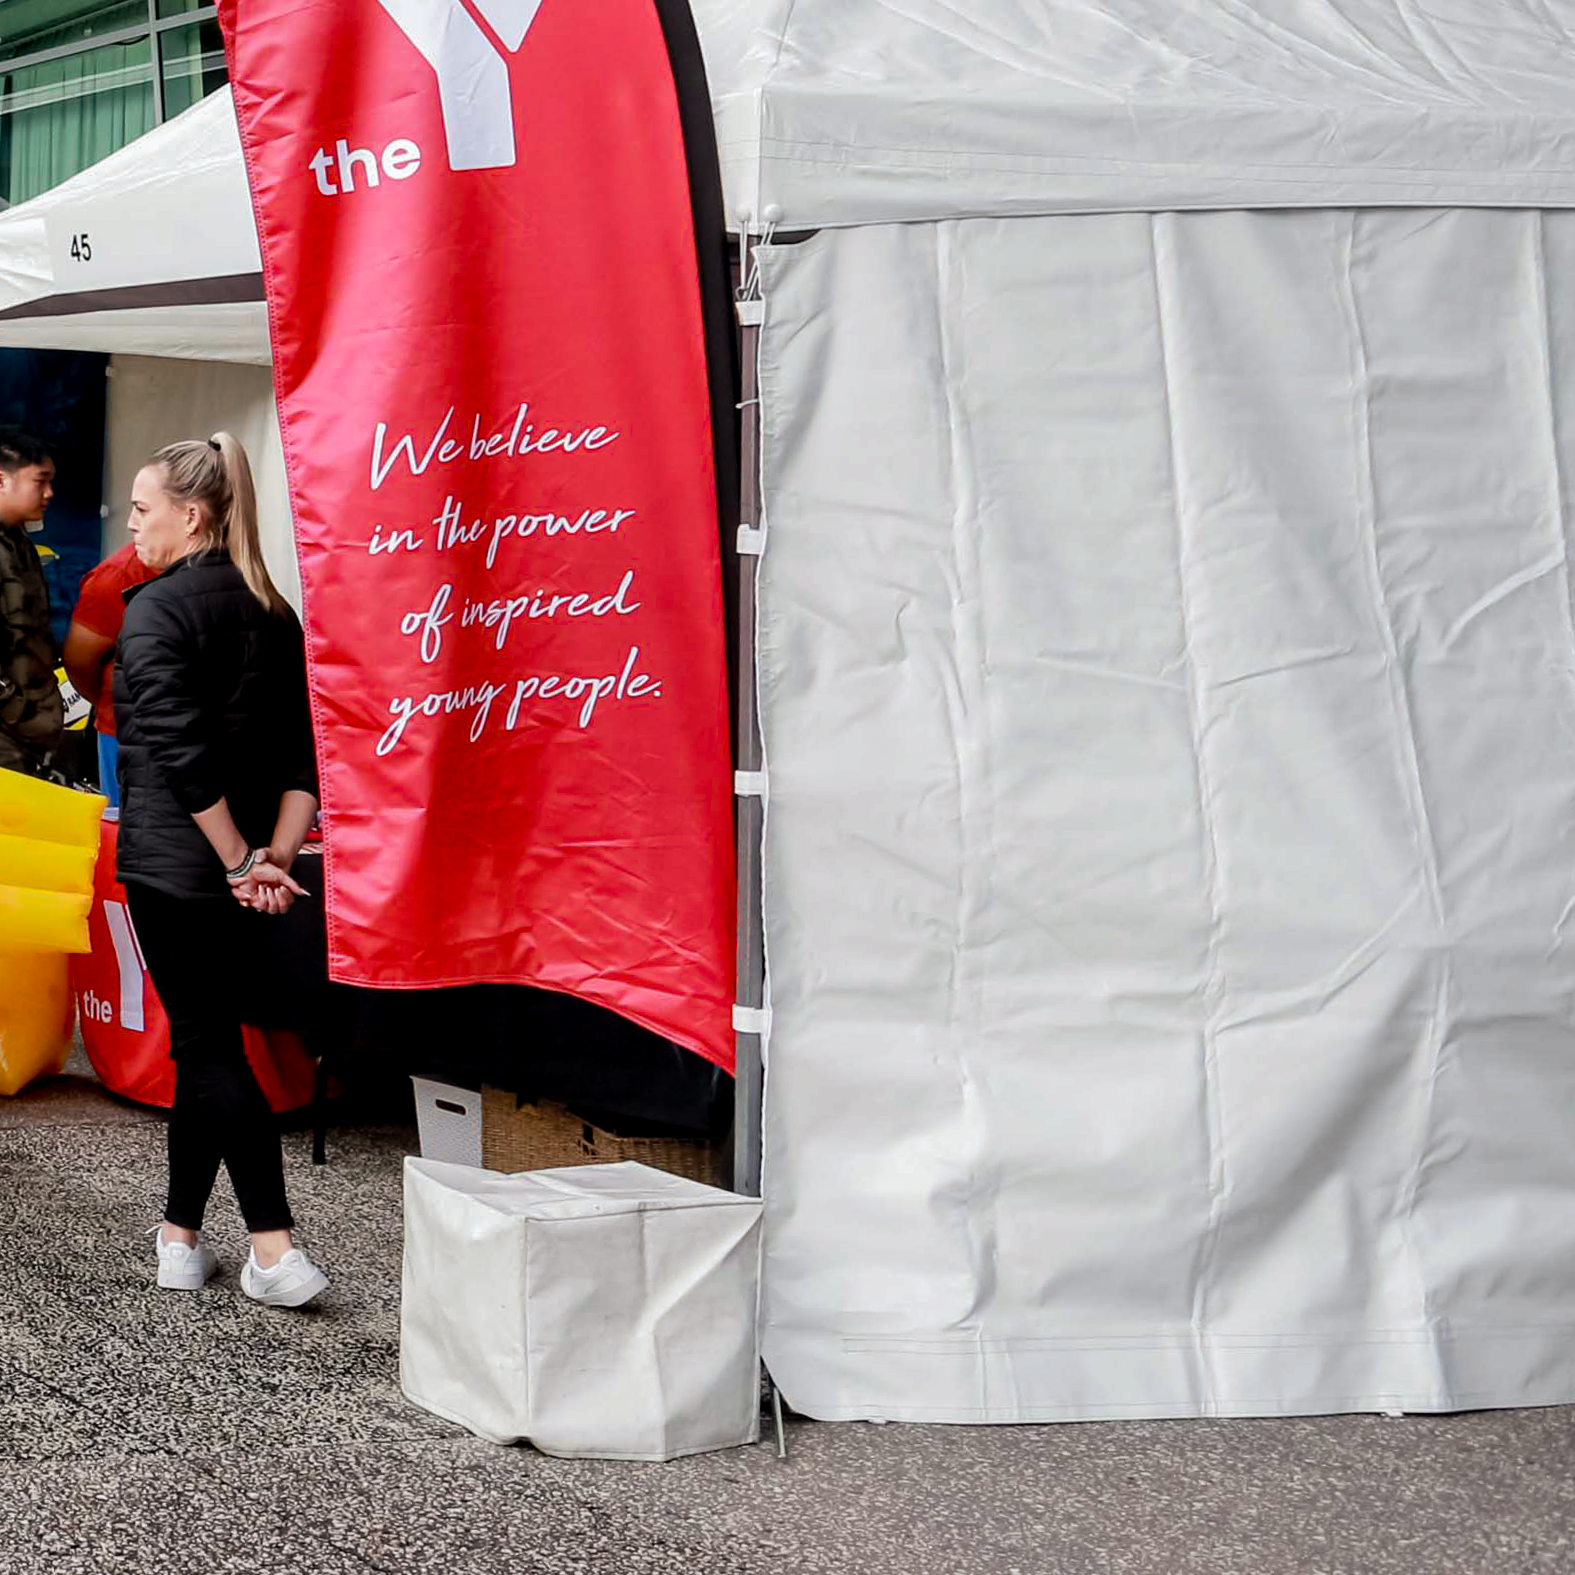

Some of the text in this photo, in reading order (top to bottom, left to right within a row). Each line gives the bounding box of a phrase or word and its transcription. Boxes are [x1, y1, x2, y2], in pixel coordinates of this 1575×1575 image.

[308, 138, 422, 196] the
[70, 234, 92, 262] 45
[370, 402, 620, 491] We believe
[368, 495, 636, 570] in the power
[401, 570, 641, 664] of inspired
[375, 646, 662, 757] young people.
[83, 989, 113, 1024] the
